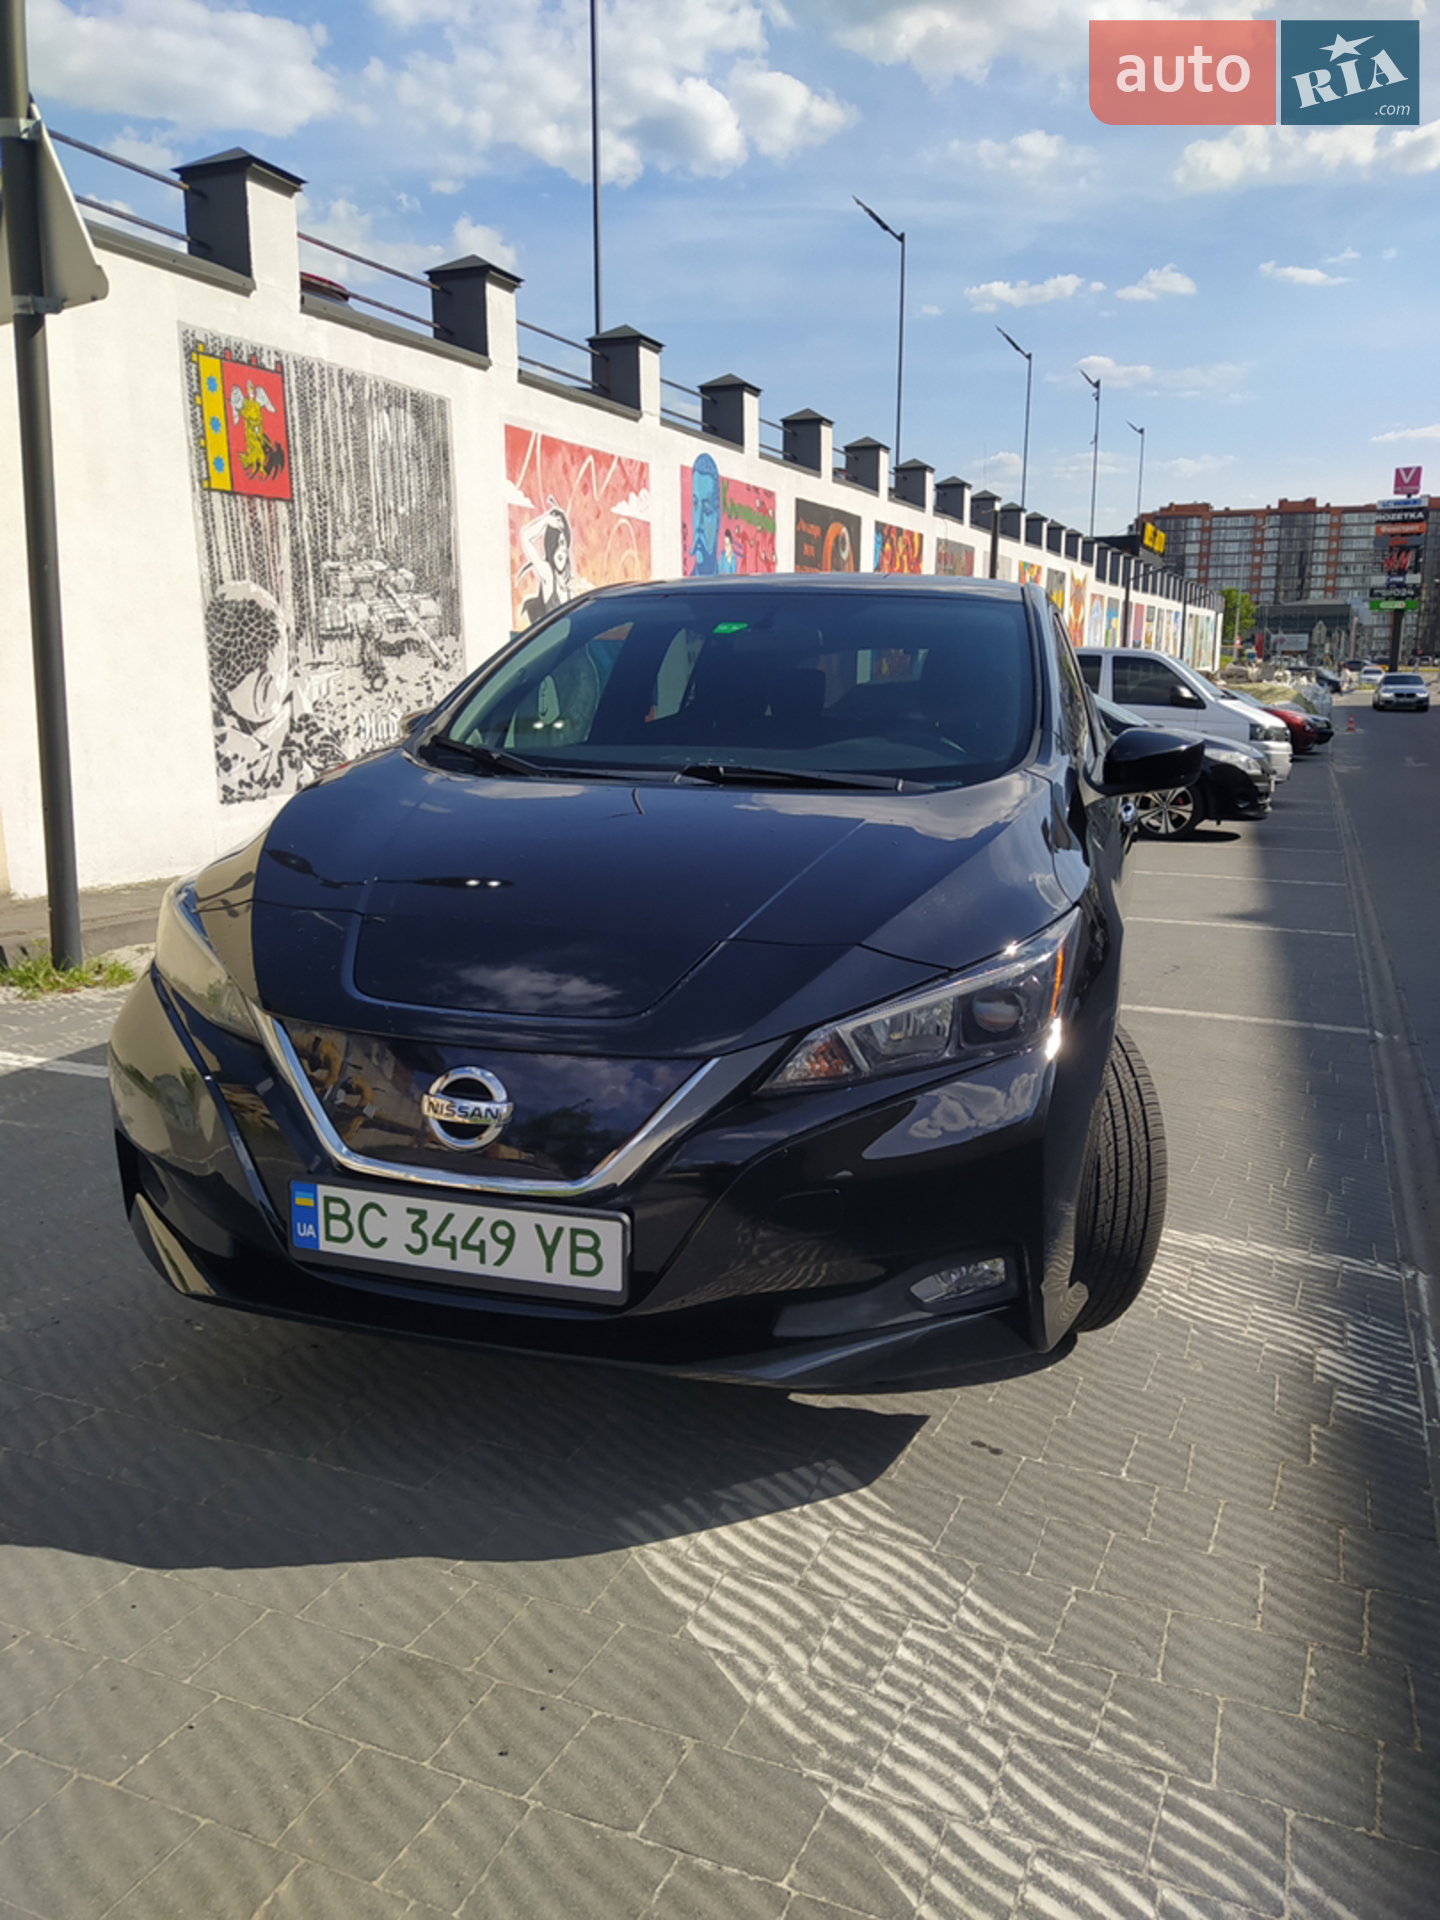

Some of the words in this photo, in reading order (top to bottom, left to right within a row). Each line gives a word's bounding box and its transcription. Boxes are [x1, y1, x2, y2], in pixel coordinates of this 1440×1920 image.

[426, 1100, 500, 1120] NISSAN
[296, 1222, 317, 1239] UA
[322, 1194, 388, 1250] BC
[404, 1206, 516, 1267] 3449
[534, 1222, 604, 1278] YB
